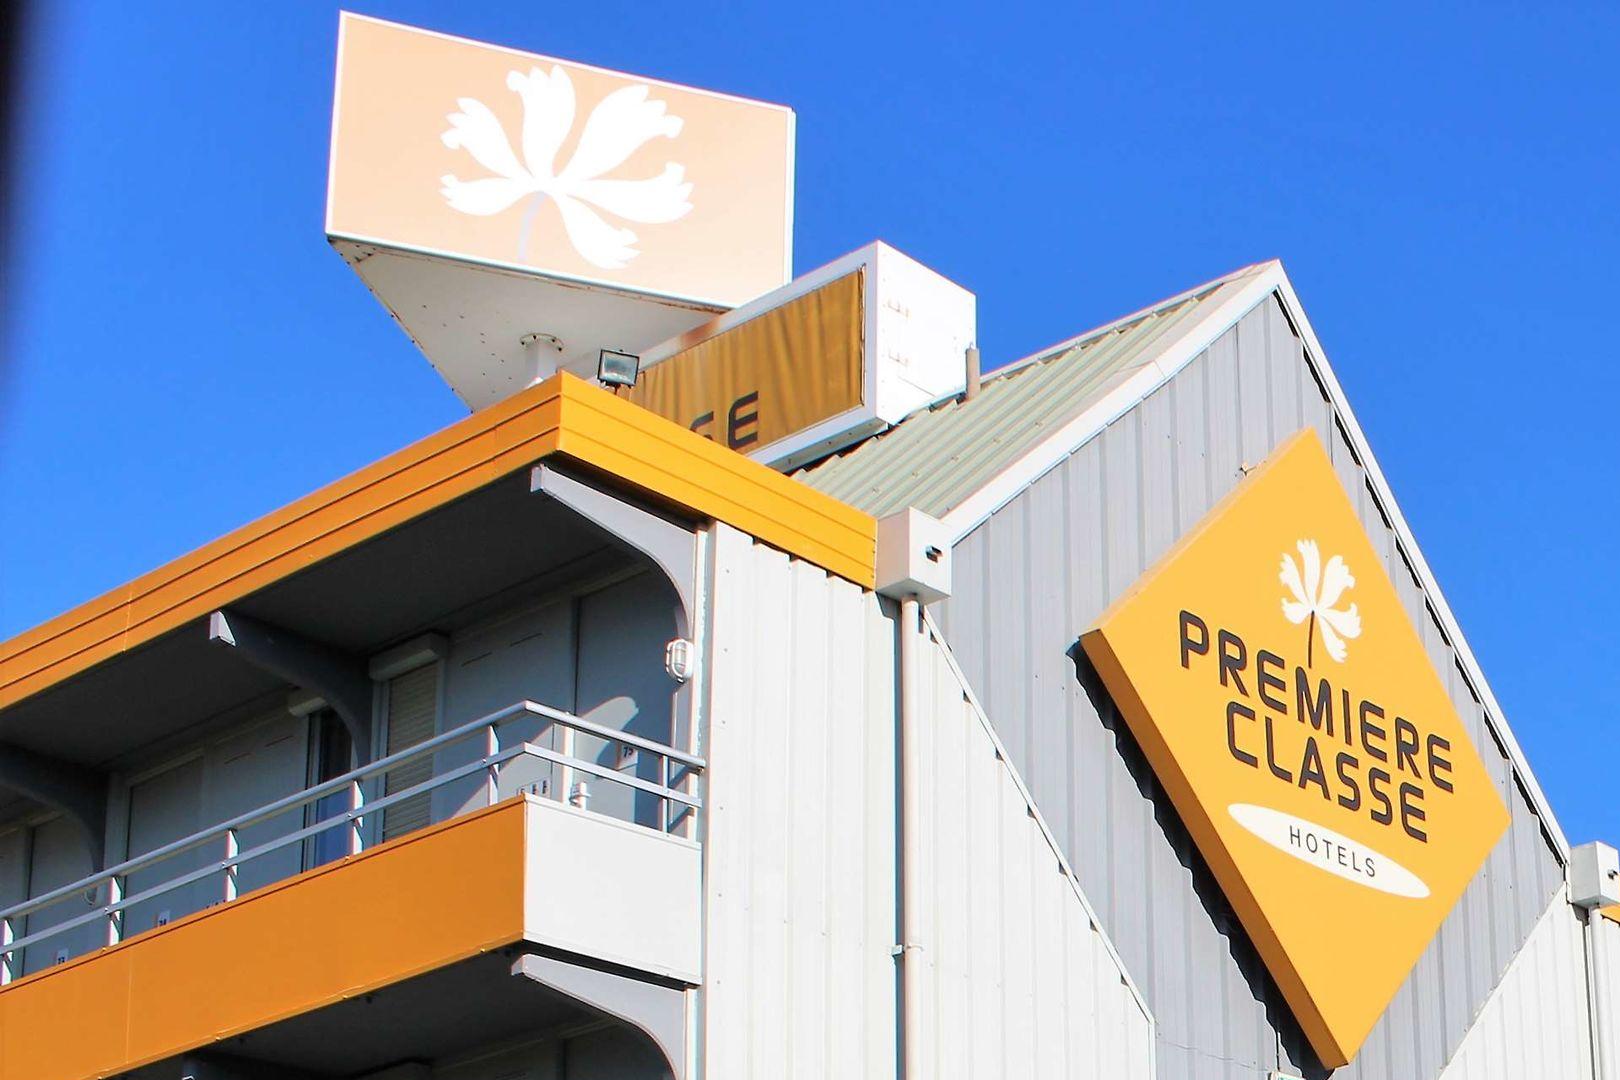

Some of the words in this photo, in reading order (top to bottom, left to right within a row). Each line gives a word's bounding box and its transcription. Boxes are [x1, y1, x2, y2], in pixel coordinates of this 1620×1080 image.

[1179, 609, 1454, 794] PREMIERE
[1226, 701, 1428, 844] CLASSE
[1288, 825, 1376, 878] HOTELS
